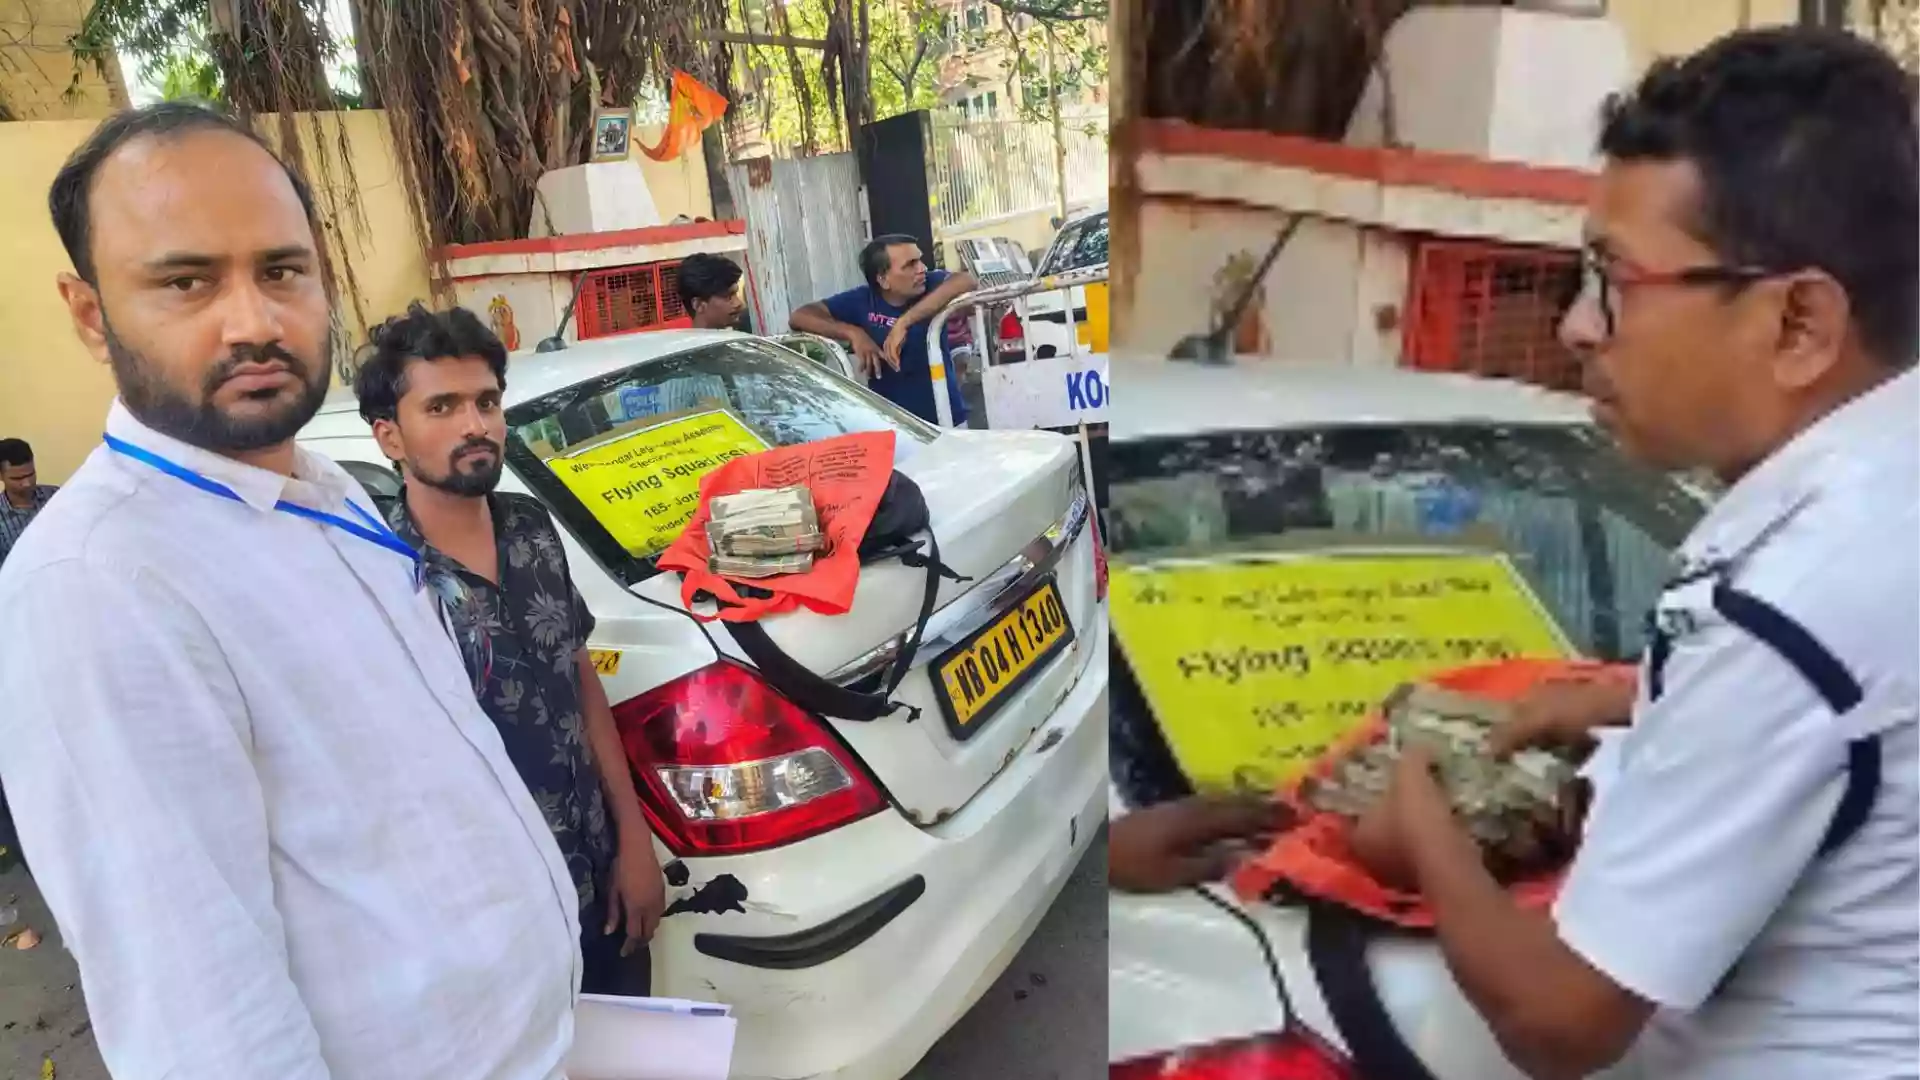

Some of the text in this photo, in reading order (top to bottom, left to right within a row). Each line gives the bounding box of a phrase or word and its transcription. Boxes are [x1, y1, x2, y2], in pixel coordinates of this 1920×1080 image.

[601, 472, 662, 504] Flying
[662, 456, 715, 479] Squad
[954, 593, 1061, 706] WB 04 H 1340
